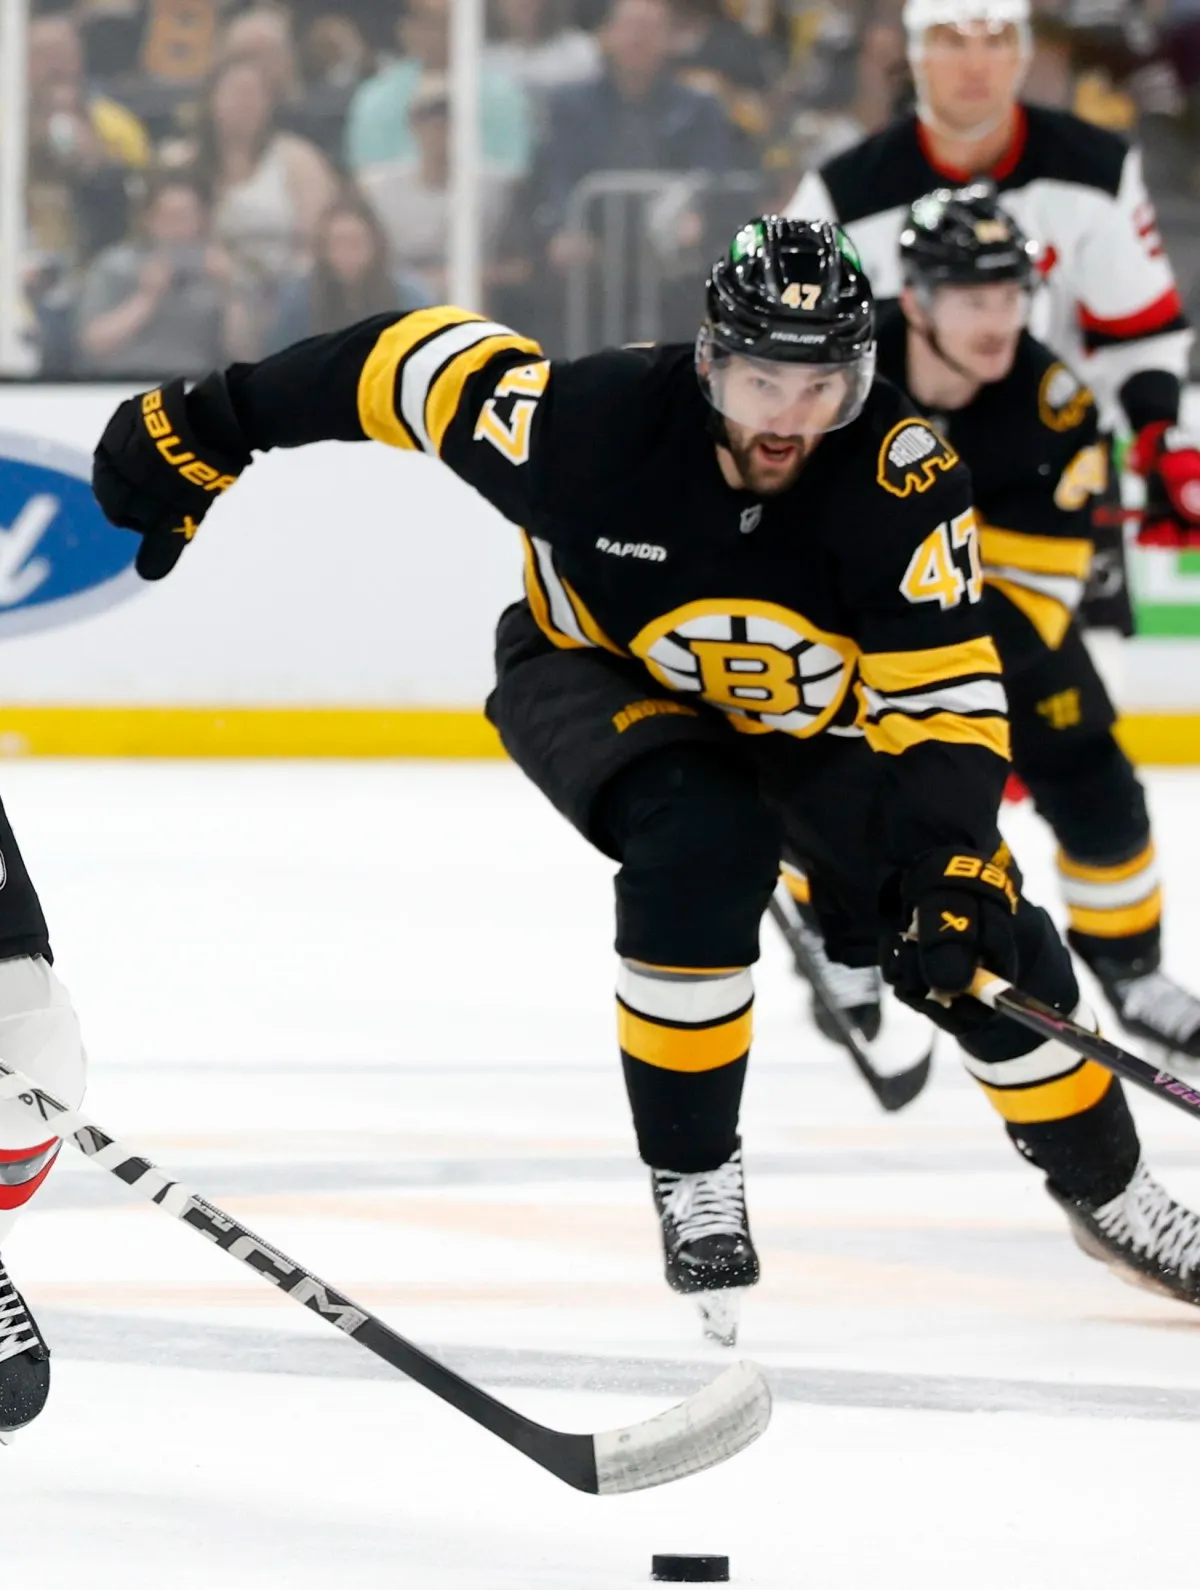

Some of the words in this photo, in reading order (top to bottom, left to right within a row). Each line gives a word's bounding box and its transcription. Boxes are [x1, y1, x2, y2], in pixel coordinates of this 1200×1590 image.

[781, 282, 821, 311] 47
[899, 506, 983, 611] 47
[689, 640, 801, 716] B
